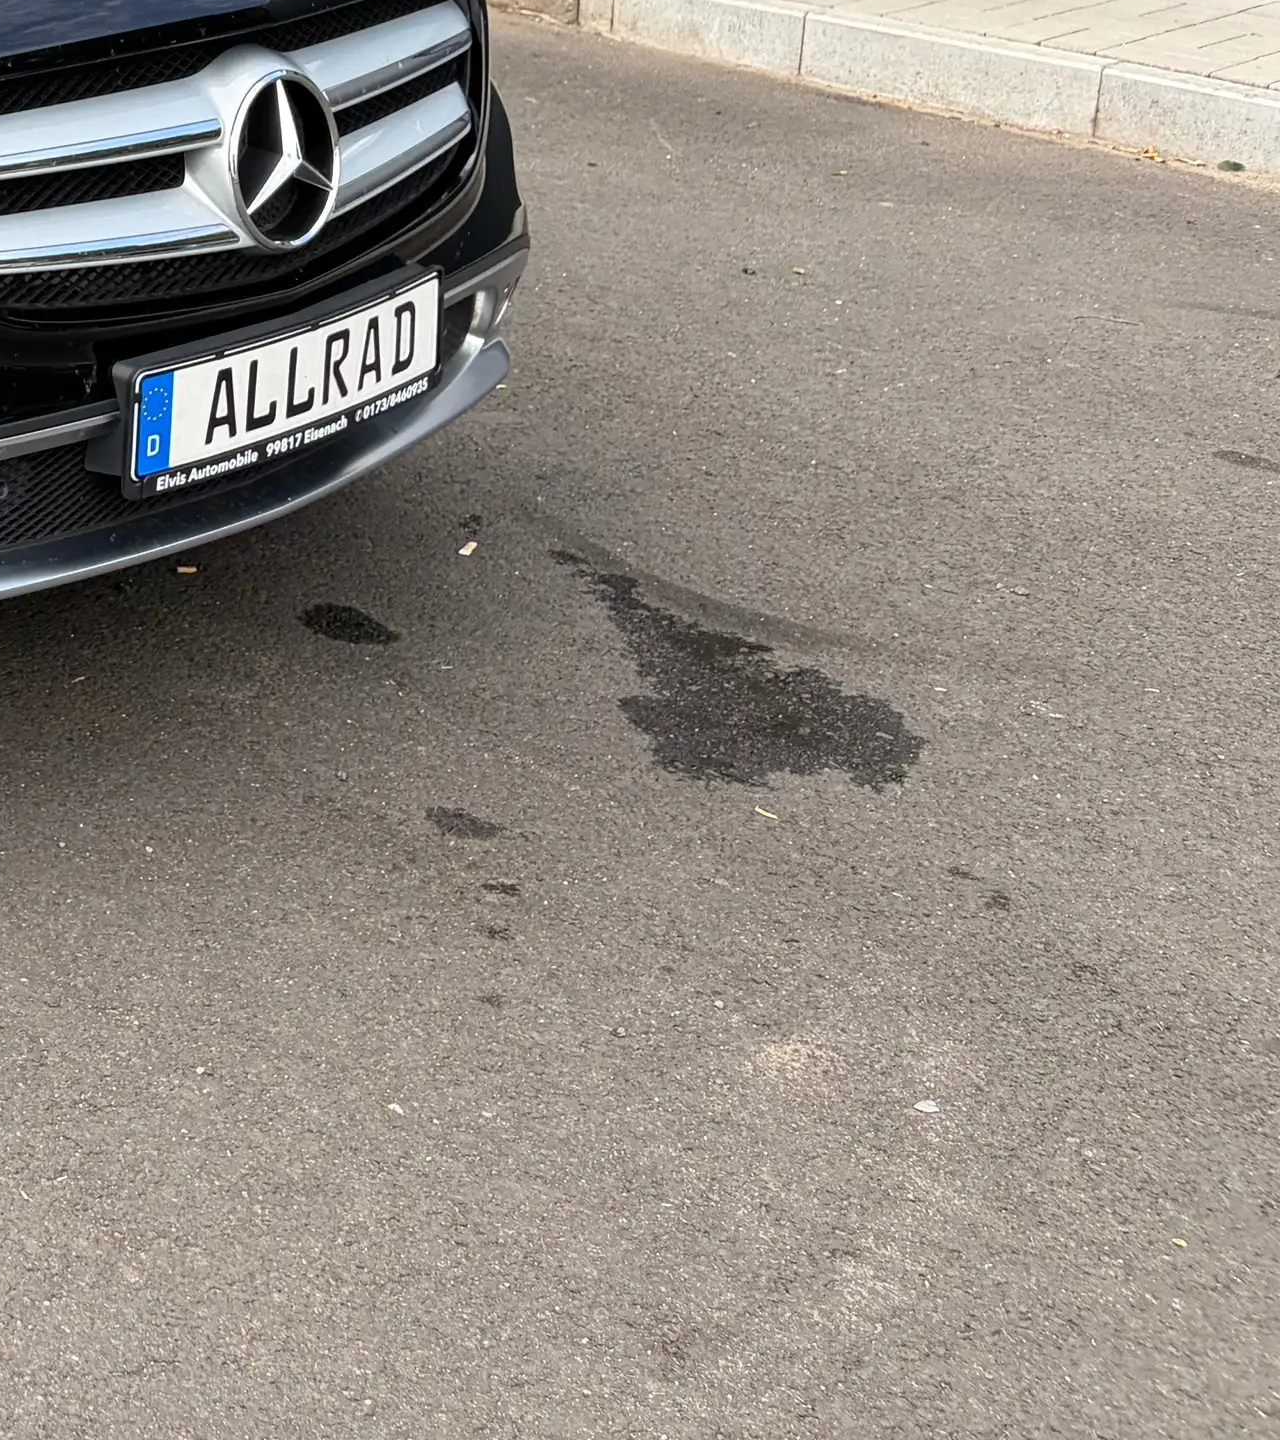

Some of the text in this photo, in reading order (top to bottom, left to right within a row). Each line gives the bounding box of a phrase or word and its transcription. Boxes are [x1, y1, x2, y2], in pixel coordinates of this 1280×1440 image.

[204, 300, 416, 445] ALLRAD
[146, 434, 160, 457] D
[156, 470, 187, 492] Elvis
[188, 449, 259, 483] Automobile
[265, 432, 302, 458] 99817
[304, 417, 348, 443] Eisenach
